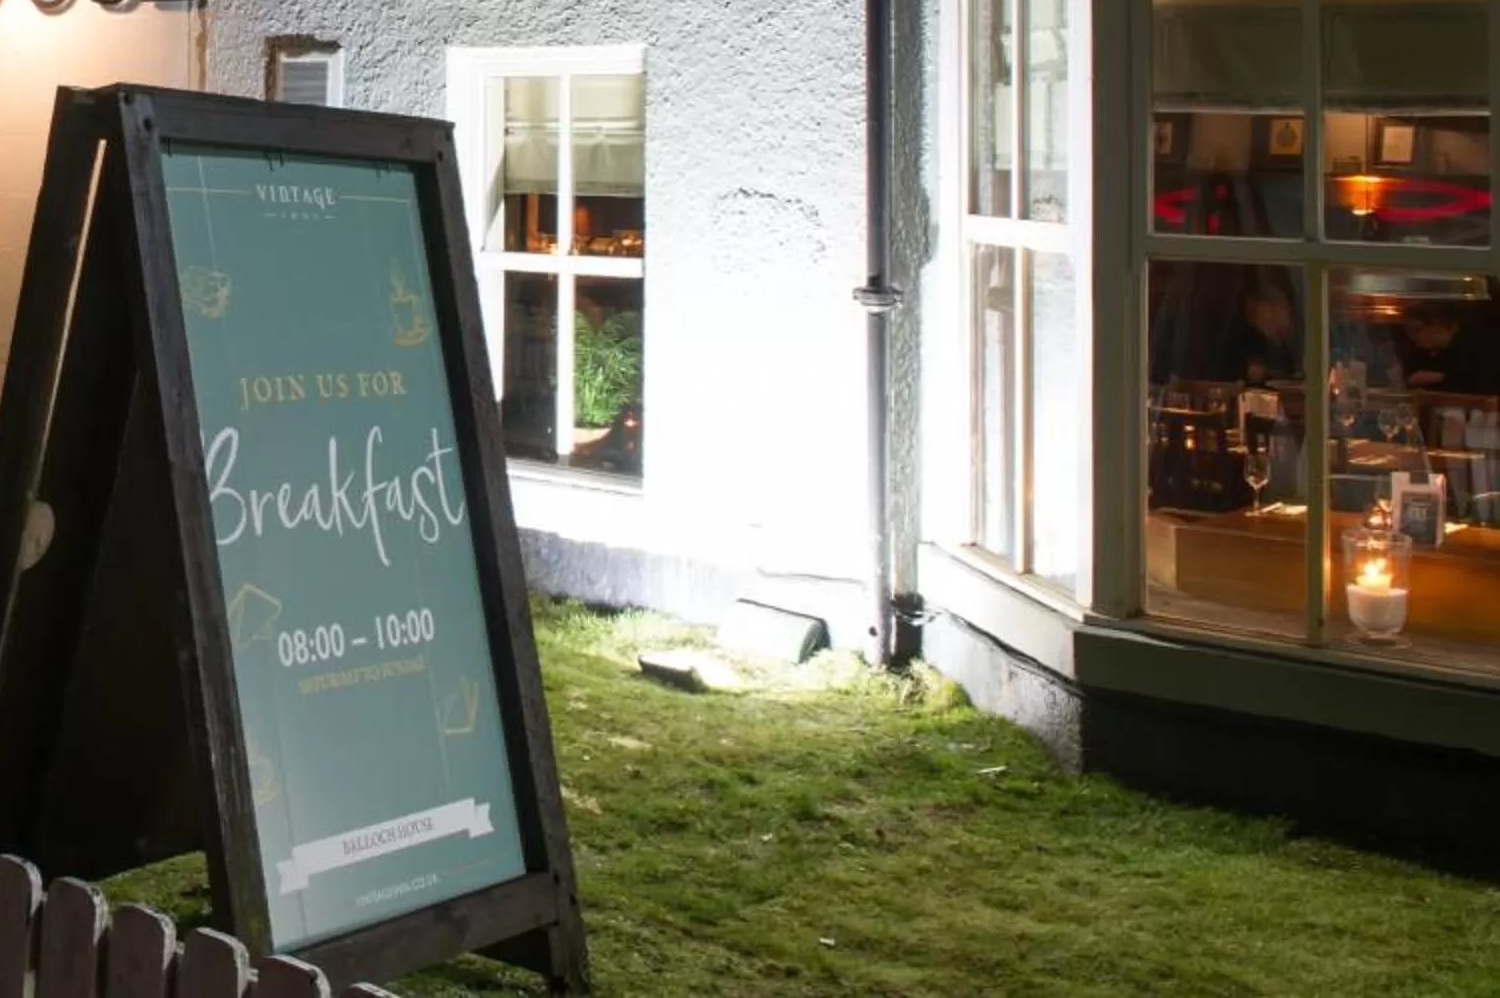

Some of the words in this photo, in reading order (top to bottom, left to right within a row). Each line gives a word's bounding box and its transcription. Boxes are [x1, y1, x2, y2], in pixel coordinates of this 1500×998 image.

[255, 184, 337, 211] VINTAGE
[240, 373, 307, 411] JOIN
[315, 373, 349, 400] US
[357, 370, 408, 398] FOR
[201, 425, 466, 568] Breakfast
[277, 621, 345, 668] 08:00
[374, 606, 436, 651] 10:00
